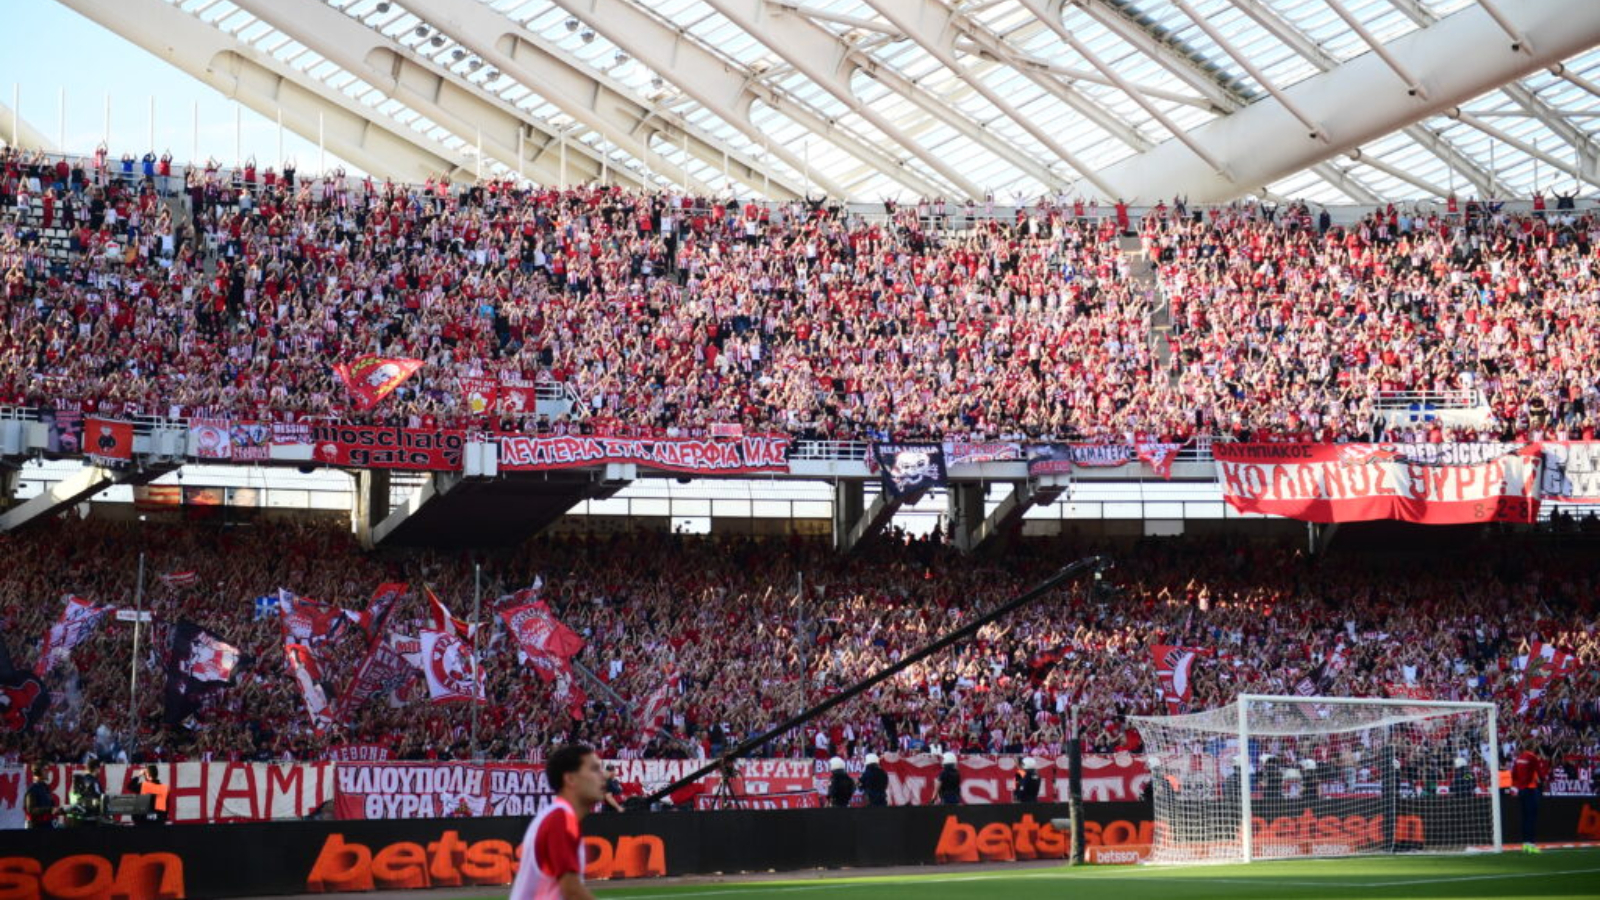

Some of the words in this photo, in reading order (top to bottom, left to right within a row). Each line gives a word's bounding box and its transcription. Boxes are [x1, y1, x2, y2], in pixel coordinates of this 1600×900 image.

[313, 426, 462, 449] moschato
[349, 448, 430, 465] gate
[443, 449, 461, 465] 7
[1218, 444, 1313, 459] ΟΛΥΜΠΙΑΚΟΣ
[337, 766, 484, 796] ΗΛΙΟΥΠΟΛΗ
[364, 794, 435, 819] ΘΥΡΑ
[309, 830, 667, 890] betson
[1097, 849, 1140, 863] betsson
